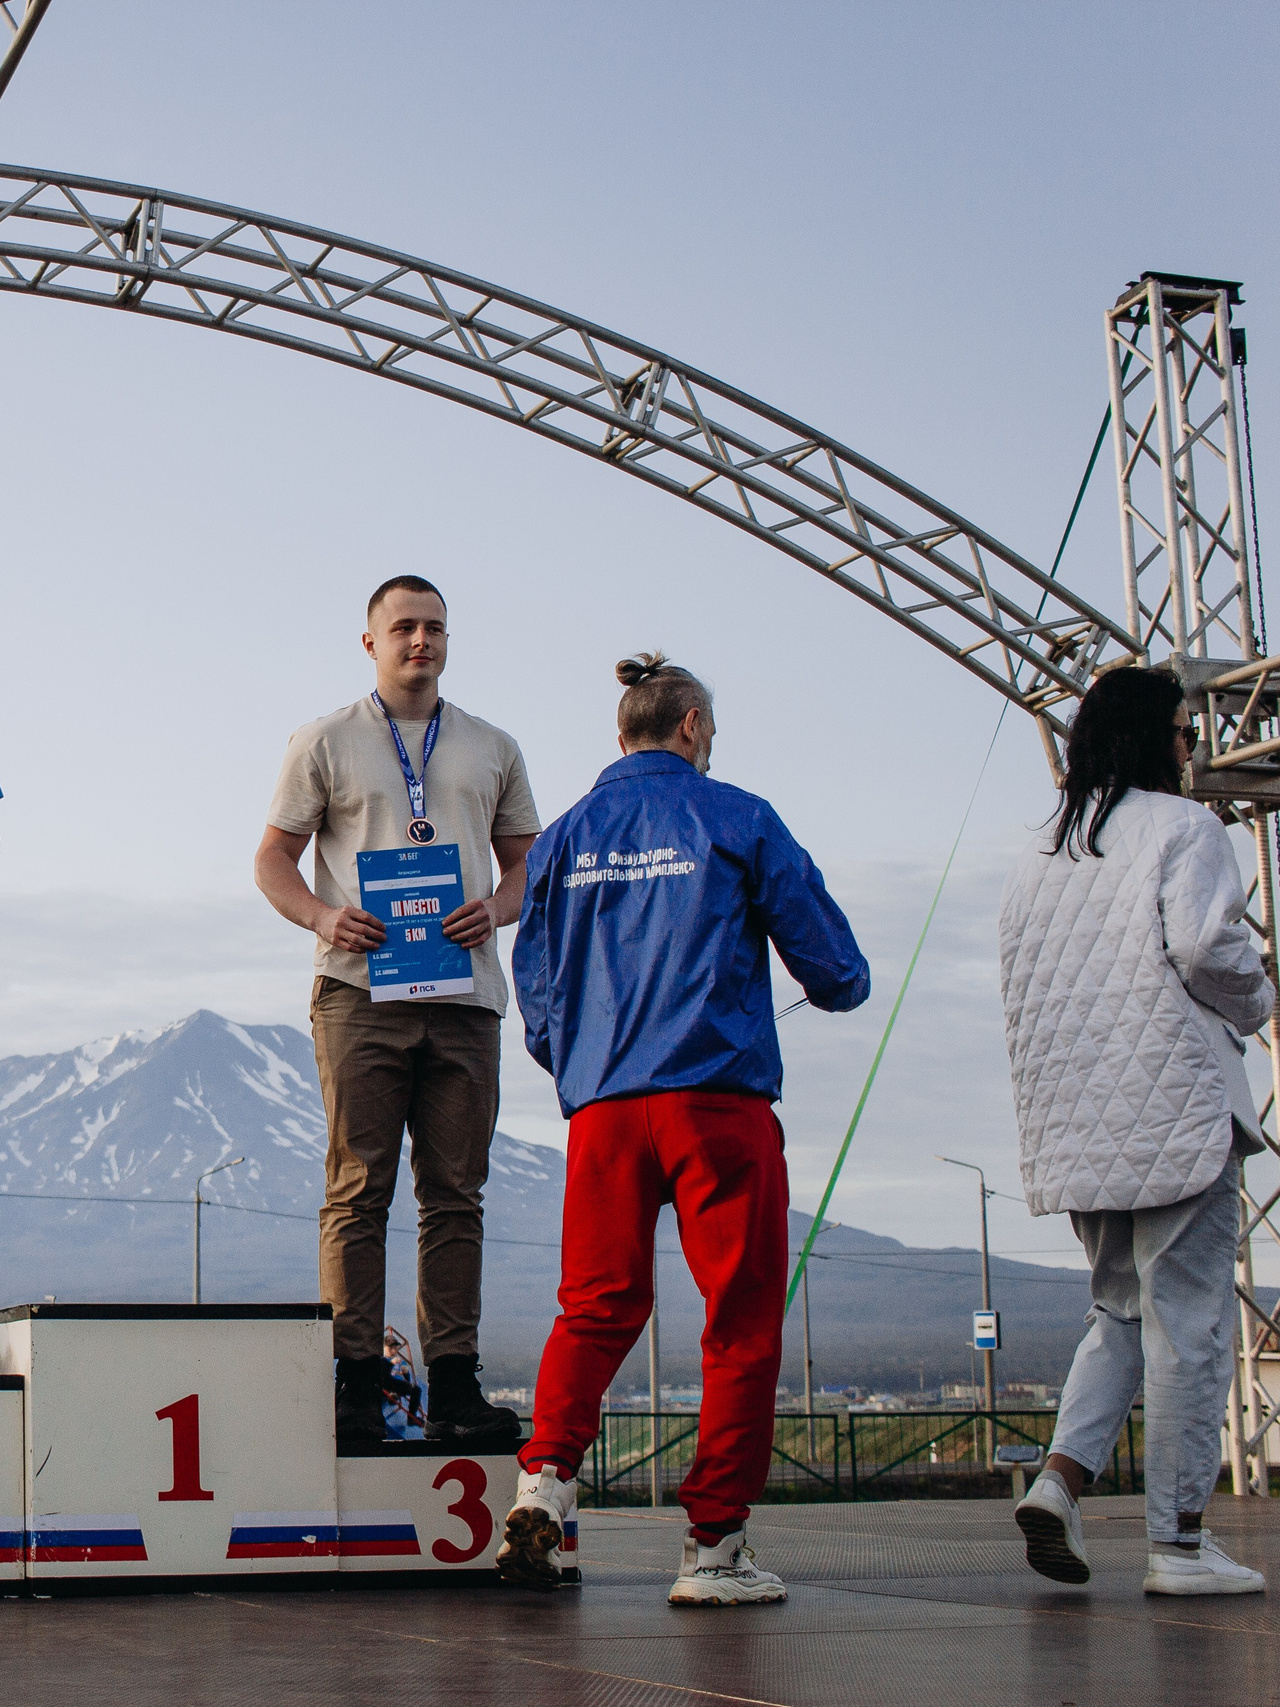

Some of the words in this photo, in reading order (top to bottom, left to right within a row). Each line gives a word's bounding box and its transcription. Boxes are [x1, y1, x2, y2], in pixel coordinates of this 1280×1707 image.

[576, 852, 597, 869] МБУ
[402, 897, 441, 916] МЕСТО
[405, 928, 411, 942] 5
[411, 927, 427, 941] КМ
[419, 985, 436, 993] ПСБ
[154, 1394, 215, 1502] 1
[430, 1458, 494, 1564] 3
